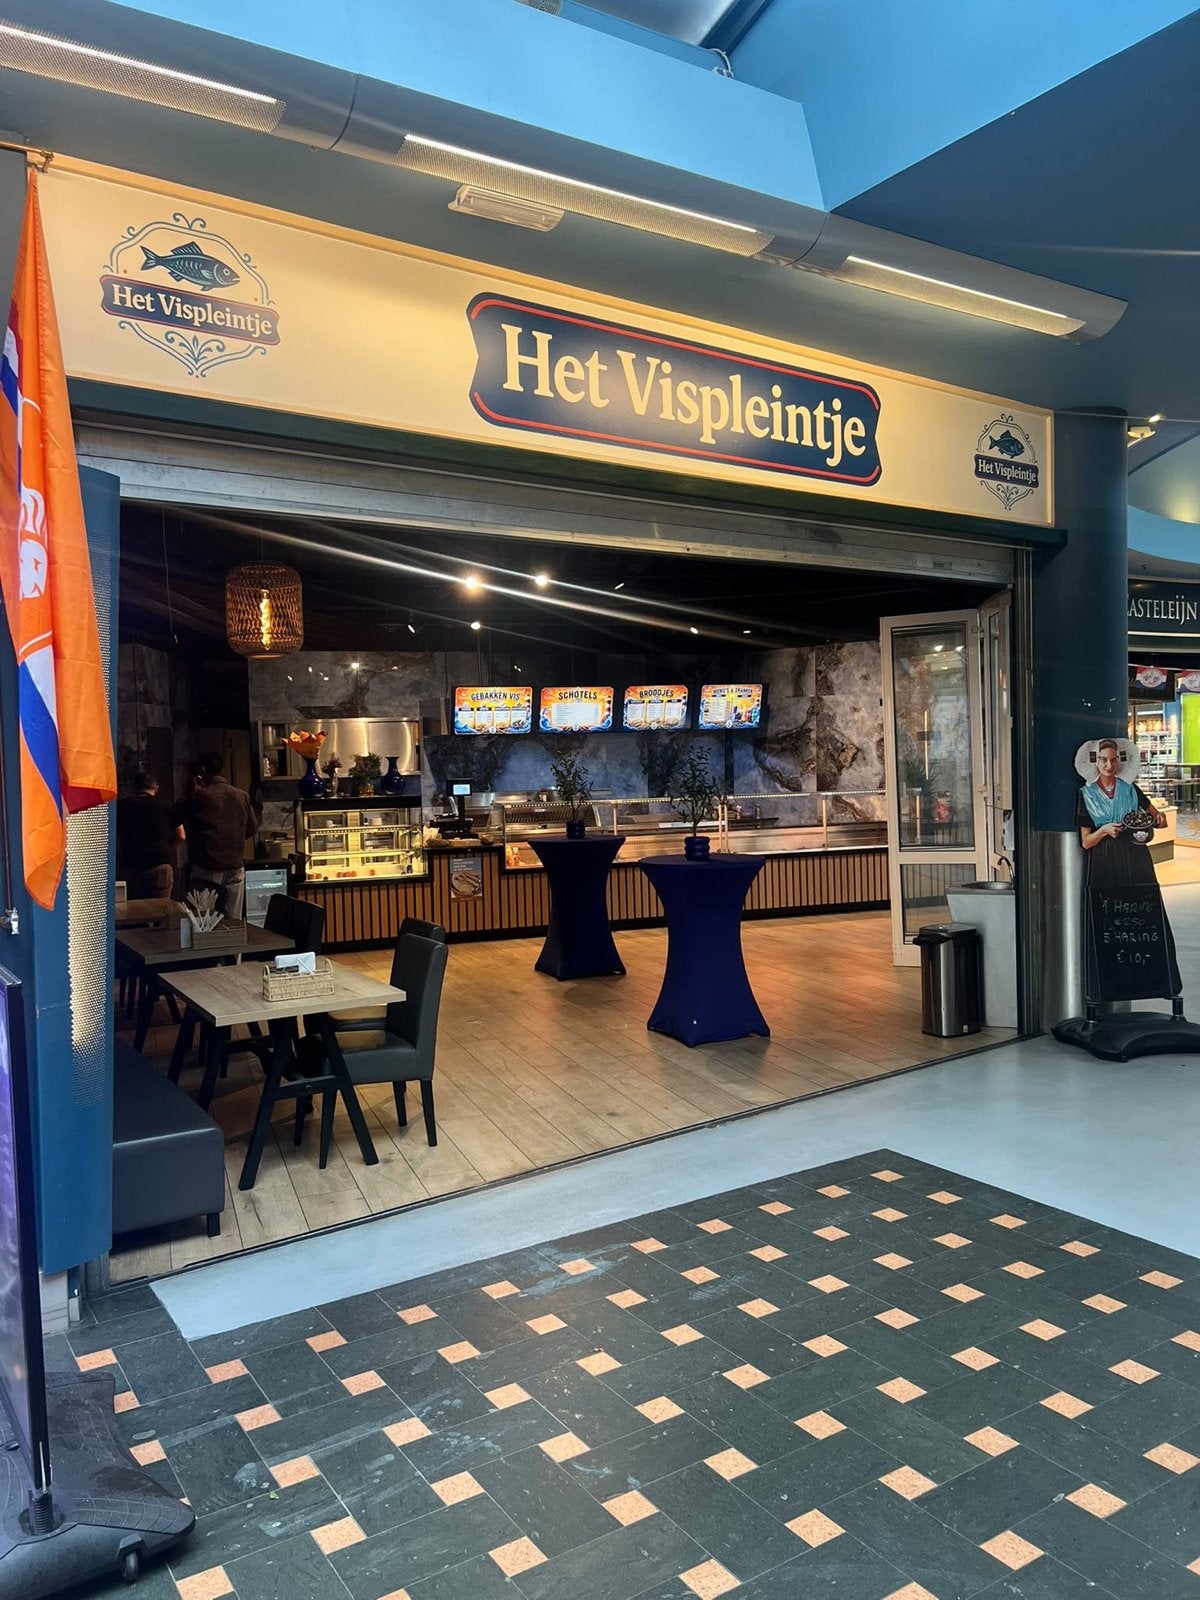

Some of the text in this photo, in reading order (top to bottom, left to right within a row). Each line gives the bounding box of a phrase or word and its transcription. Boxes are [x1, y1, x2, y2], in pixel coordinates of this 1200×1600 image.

[111, 283, 273, 338] Het Vispleintje
[500, 323, 867, 468] Het Vispleintje
[978, 459, 1036, 484] Het Vispleintje
[1127, 595, 1198, 625] ASTELEIJN
[471, 690, 520, 701] GEBAKKEN VIS
[558, 690, 598, 700] SCHOTELS
[639, 688, 675, 698] BROODJES
[1113, 930, 1159, 944] HARING
